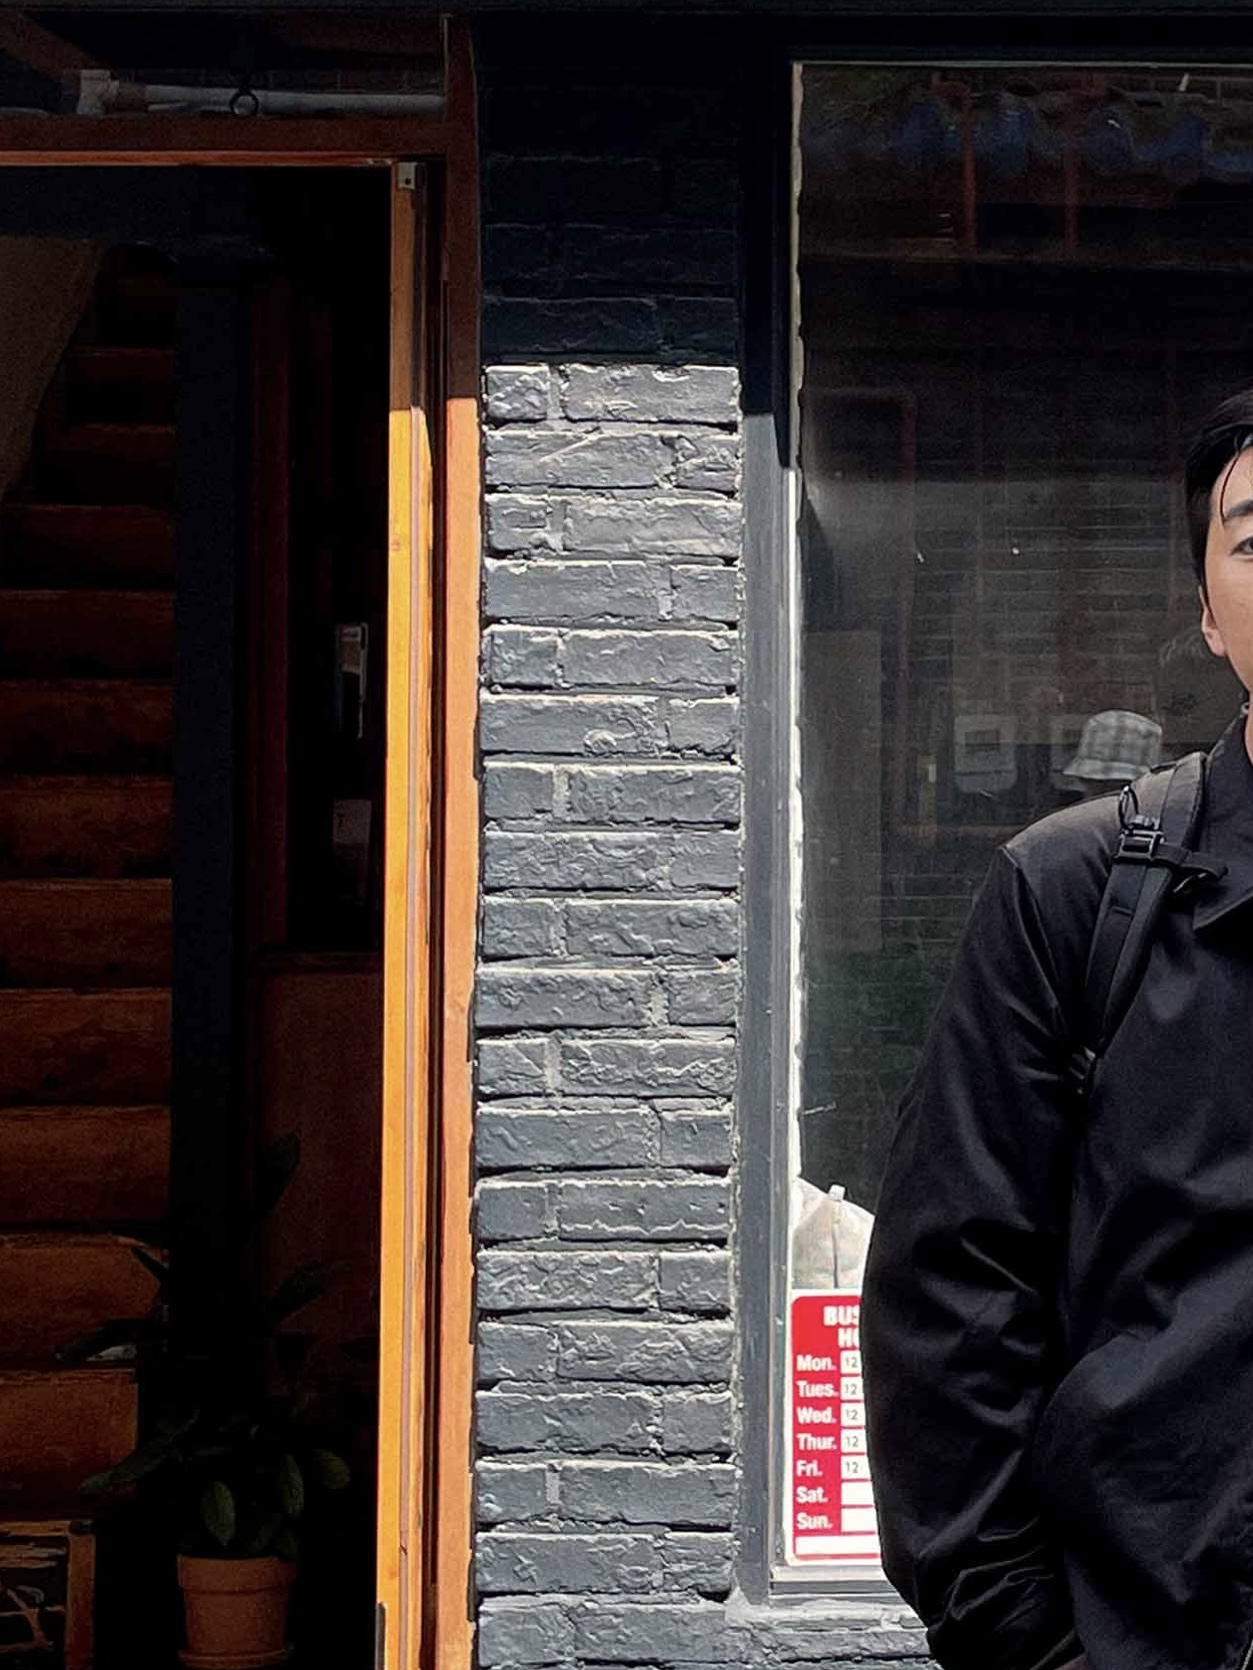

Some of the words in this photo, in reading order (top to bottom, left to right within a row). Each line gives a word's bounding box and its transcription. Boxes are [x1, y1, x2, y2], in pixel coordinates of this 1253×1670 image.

[796, 1354, 837, 1372] Mon.
[796, 1380, 839, 1398] Tues.
[796, 1406, 837, 1424] Wed.
[796, 1433, 838, 1451] Thur.
[796, 1460, 824, 1478] Fri.
[796, 1486, 829, 1504] Sat.
[796, 1512, 833, 1531] Sun.
